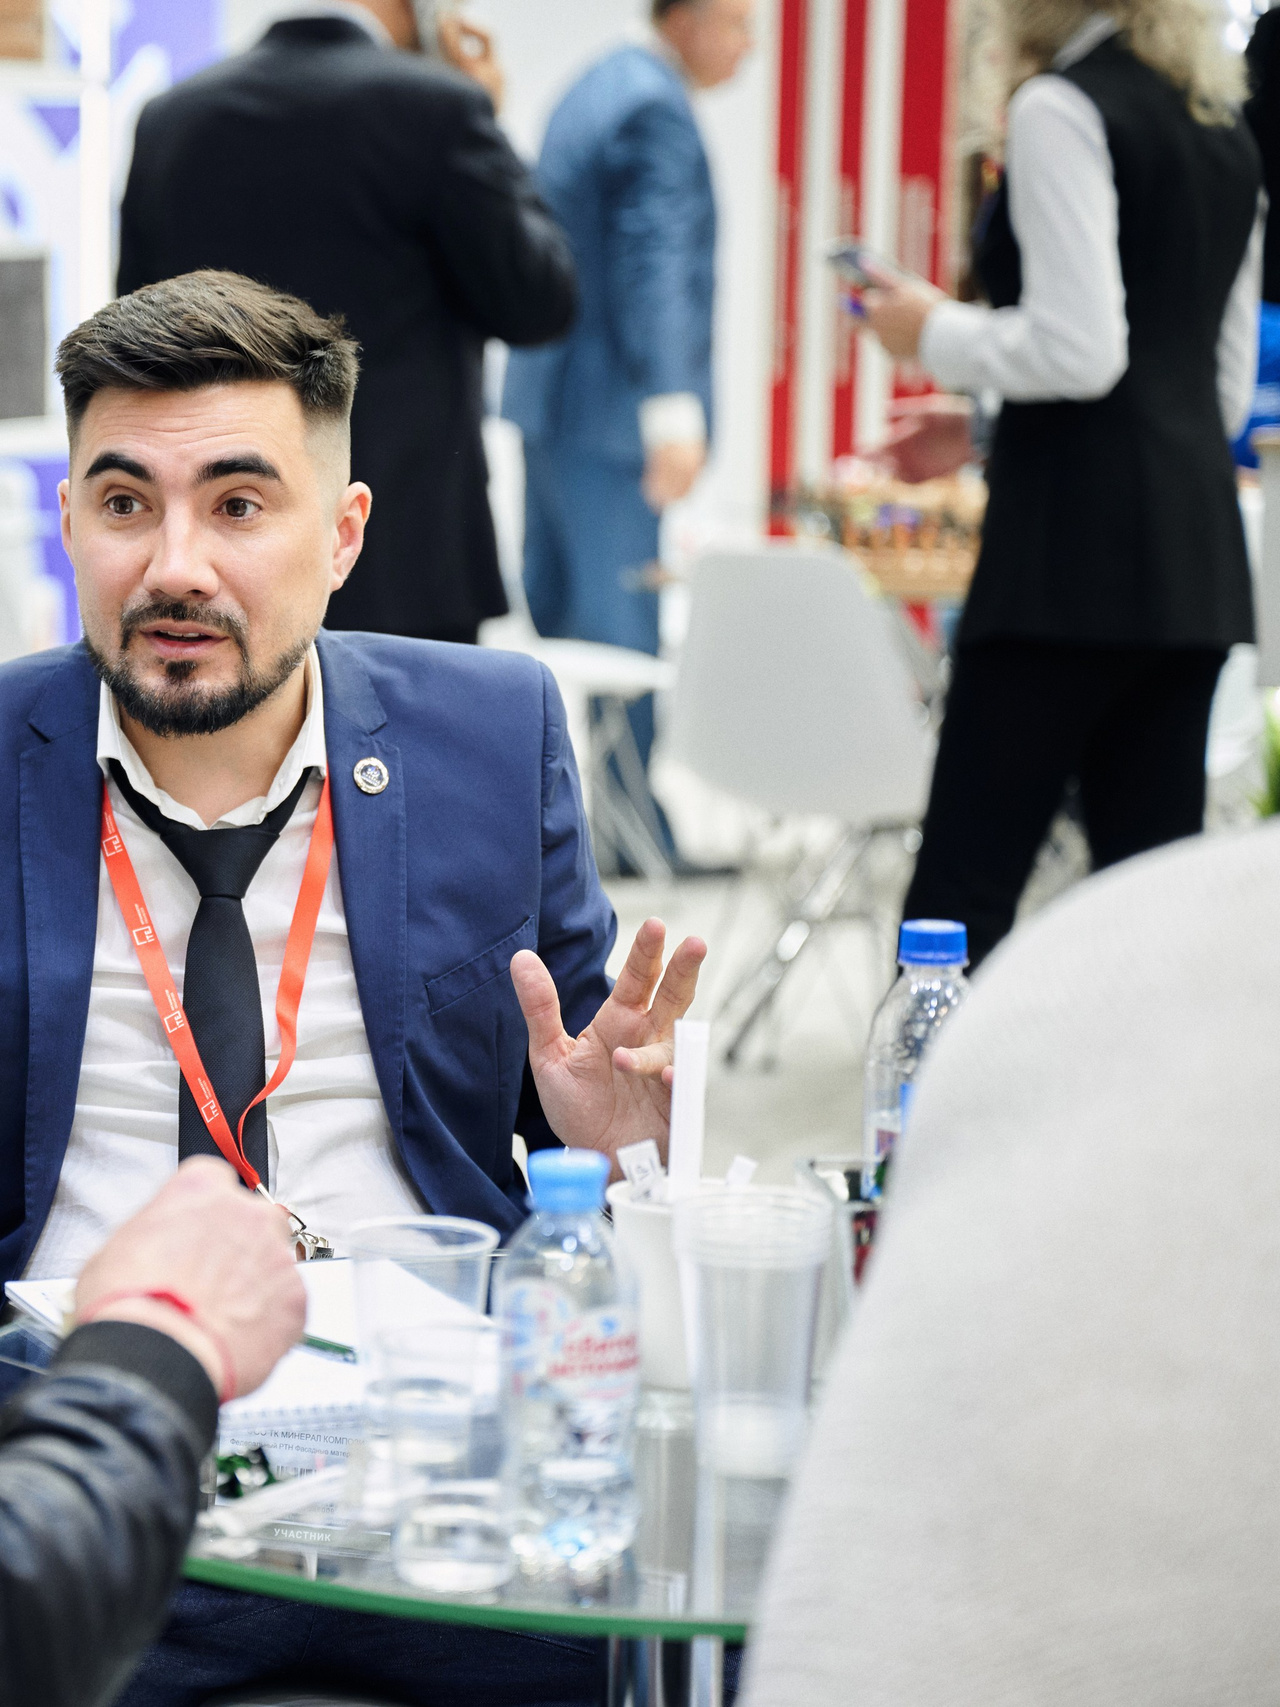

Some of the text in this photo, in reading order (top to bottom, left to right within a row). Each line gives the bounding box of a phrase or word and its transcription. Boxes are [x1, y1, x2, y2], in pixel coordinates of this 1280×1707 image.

[280, 1431, 321, 1442] МИНЕРАЛ
[323, 1435, 365, 1446] КОМПОЗИ
[279, 1443, 294, 1451] РТН
[330, 1449, 351, 1458] матер
[273, 1528, 332, 1542] УЧАСТНИК
